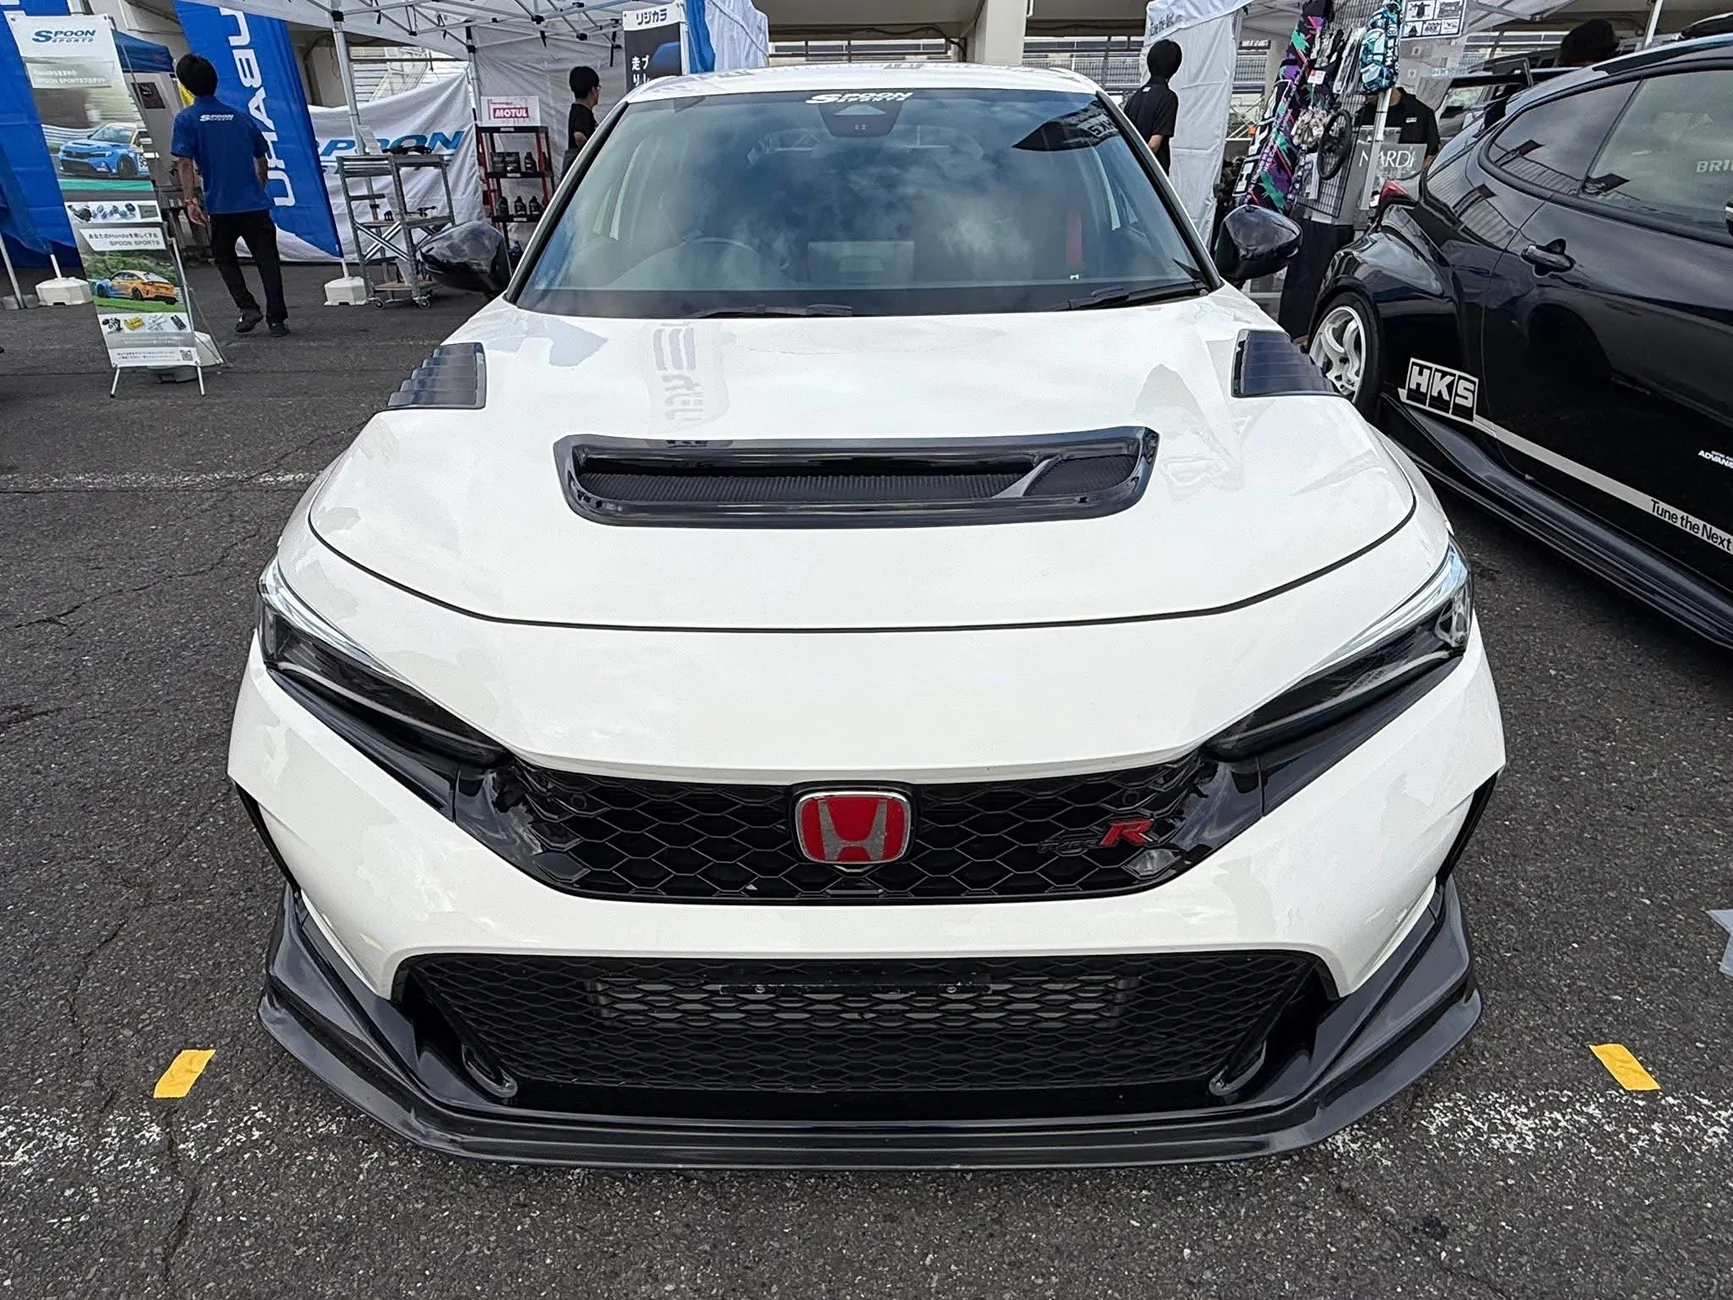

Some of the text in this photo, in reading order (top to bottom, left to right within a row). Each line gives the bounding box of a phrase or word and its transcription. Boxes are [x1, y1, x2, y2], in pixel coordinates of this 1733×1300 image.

[636, 8, 668, 26] リジカラ
[32, 29, 96, 43] SPOON
[805, 91, 914, 104] SPOON
[200, 114, 234, 122] SPOON
[494, 108, 528, 118] MOTUL
[1409, 365, 1475, 408] HKS
[1650, 498, 1732, 551] Tune the Next
[1098, 818, 1155, 847] R
